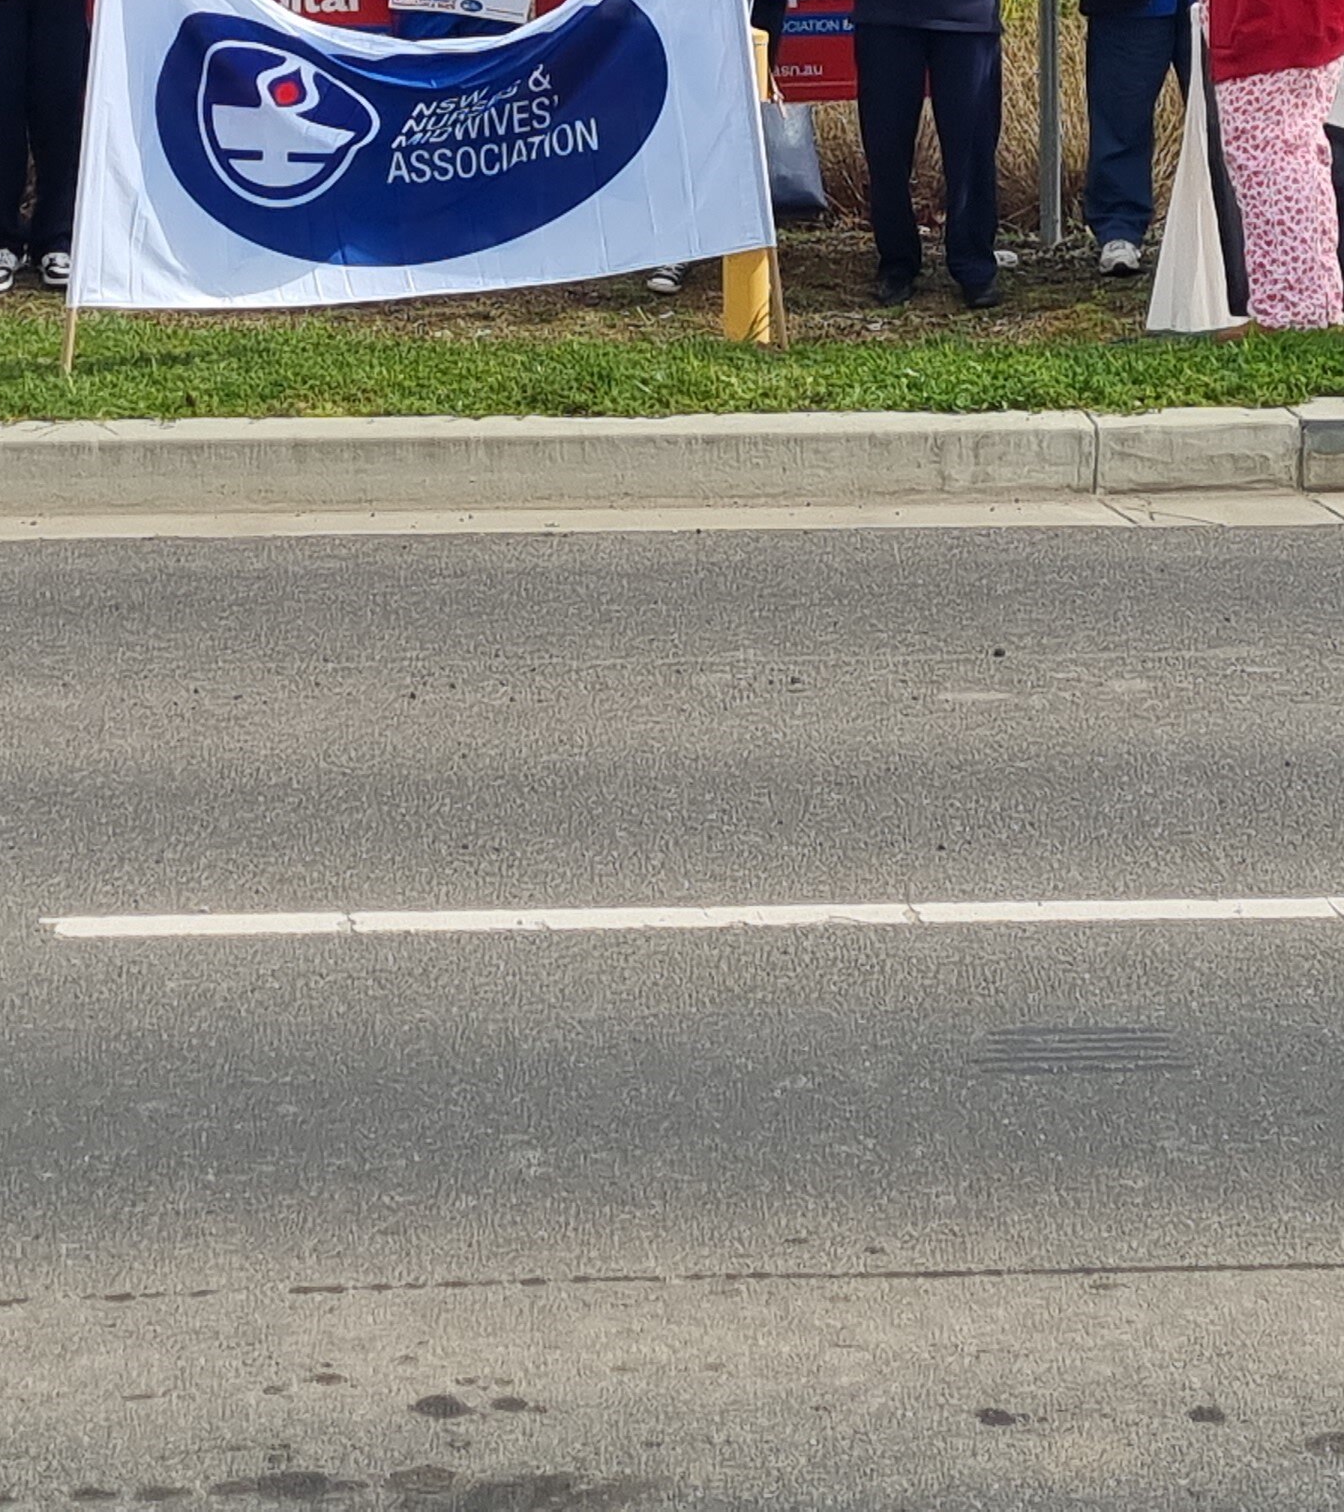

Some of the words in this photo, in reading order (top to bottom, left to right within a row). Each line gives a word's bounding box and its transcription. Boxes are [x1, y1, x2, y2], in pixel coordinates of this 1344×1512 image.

[783, 18, 840, 33] CIATION
[527, 63, 553, 93] &
[411, 86, 491, 118] NSW
[387, 117, 600, 184] ASSOCIATION
